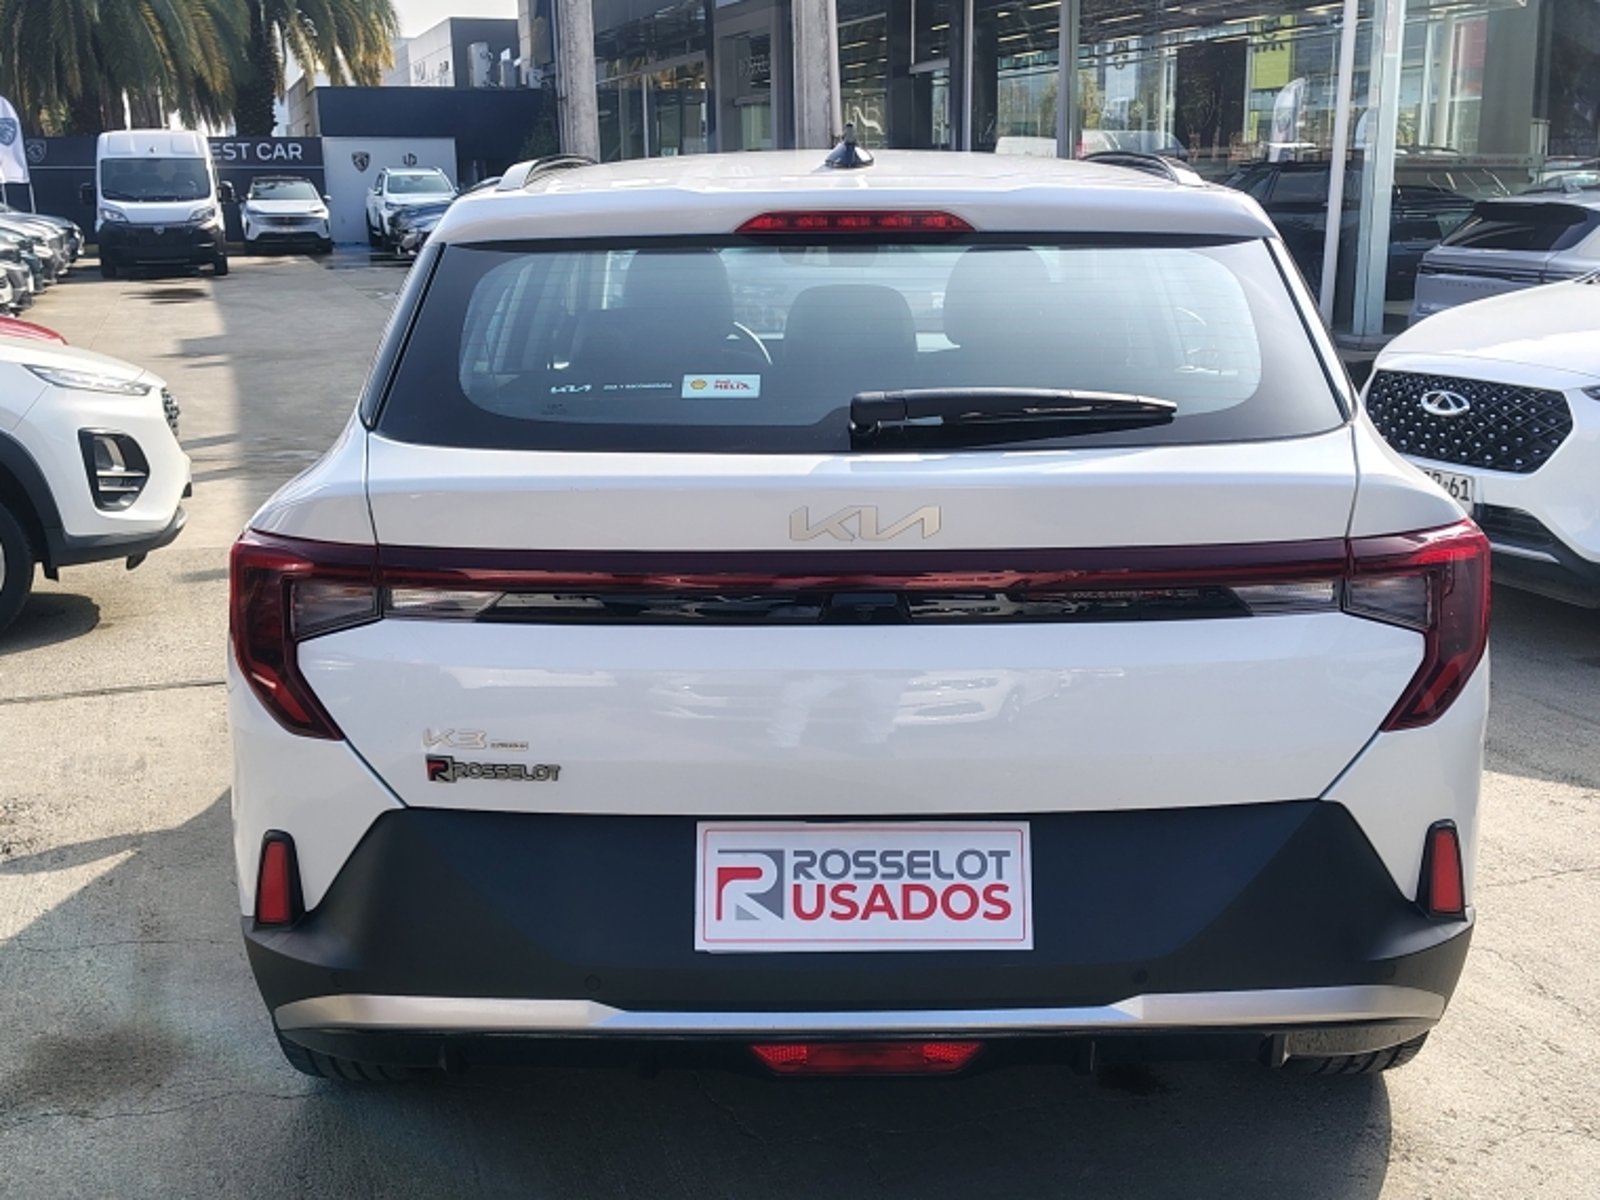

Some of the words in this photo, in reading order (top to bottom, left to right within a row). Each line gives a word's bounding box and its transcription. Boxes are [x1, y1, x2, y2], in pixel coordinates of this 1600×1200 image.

[210, 142, 251, 160] EST
[256, 142, 303, 160] CAR
[789, 505, 942, 541] KIA
[423, 728, 487, 750] K3
[453, 761, 561, 782] ROSSELOT
[793, 850, 1011, 881] ROSSELOT
[793, 883, 1013, 921] USADOS
